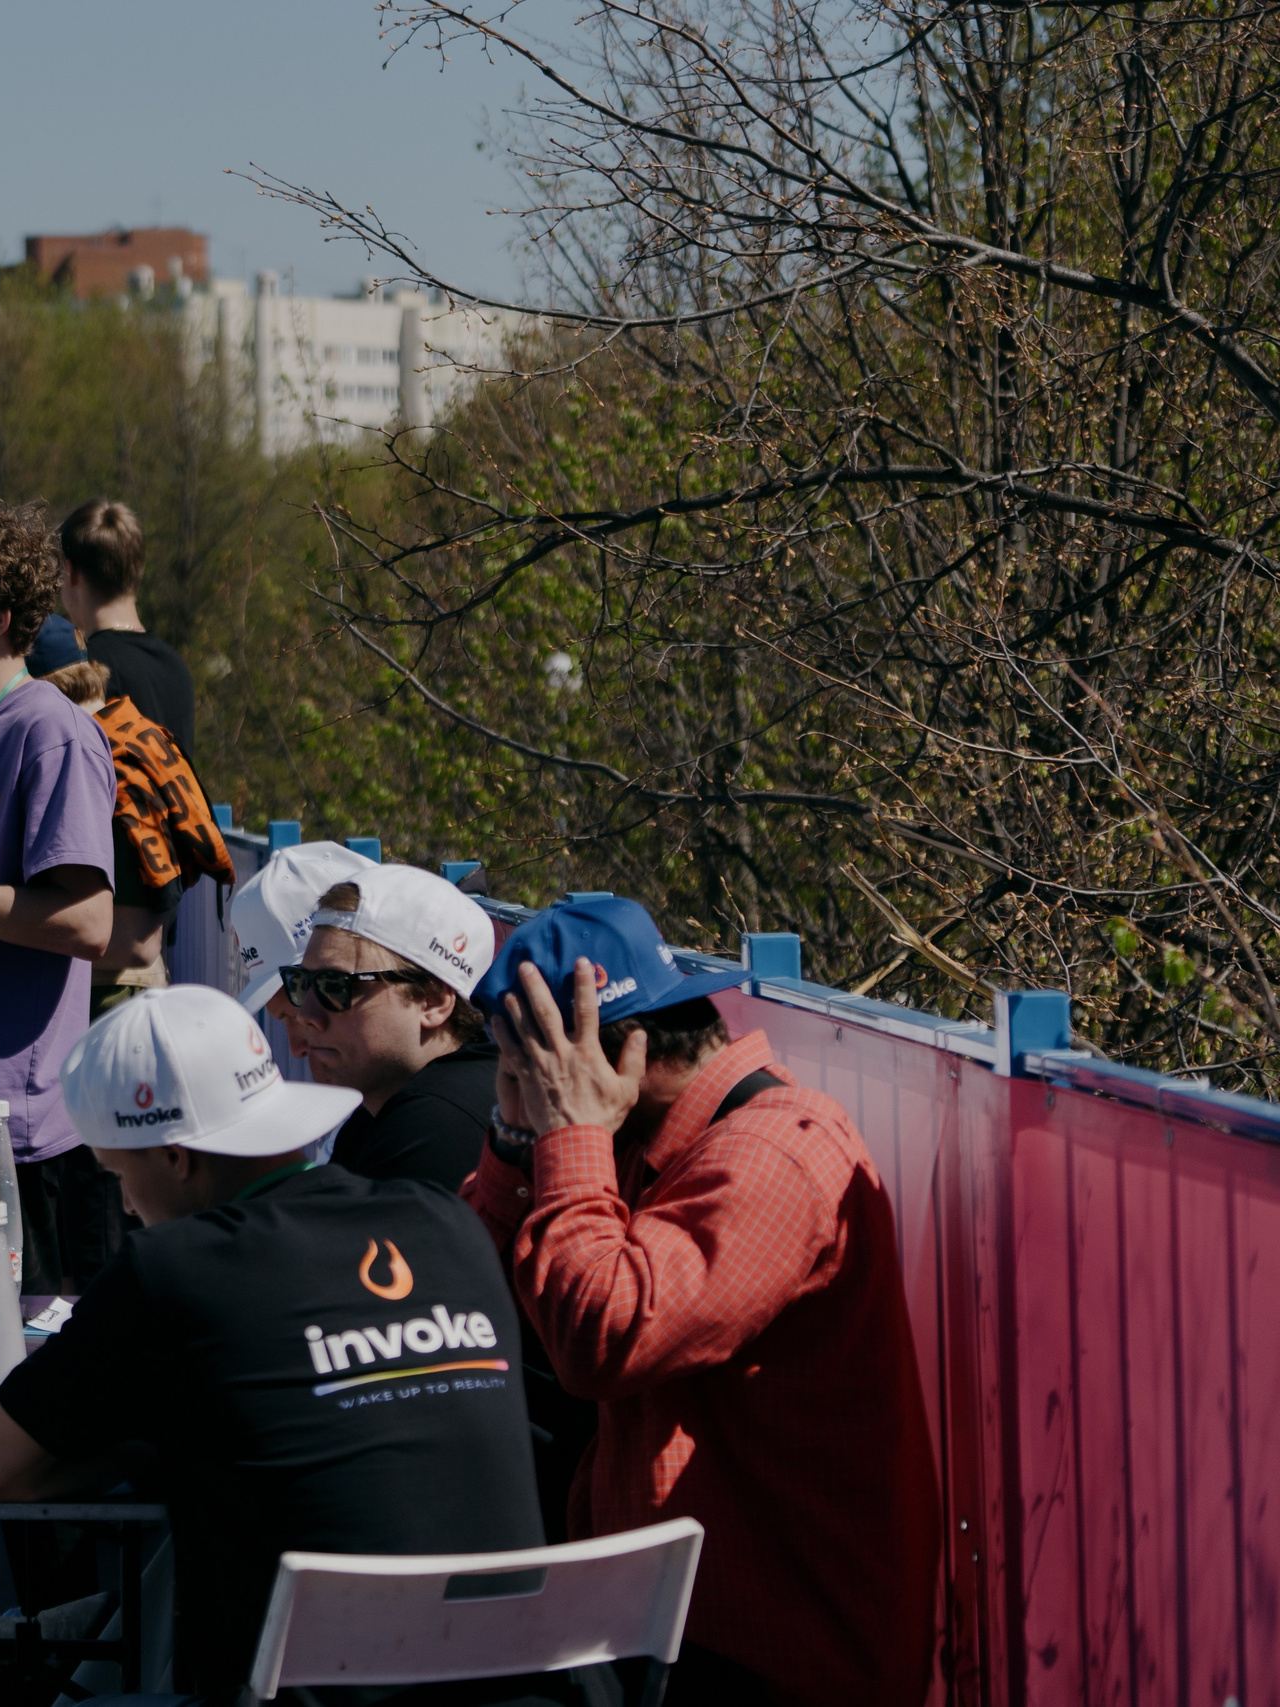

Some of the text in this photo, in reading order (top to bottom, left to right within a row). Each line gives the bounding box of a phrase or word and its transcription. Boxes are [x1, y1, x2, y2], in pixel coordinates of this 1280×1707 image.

[428, 937, 474, 978] invoke
[234, 1058, 275, 1092] invo
[115, 1107, 183, 1128] invoke
[304, 1304, 497, 1374] invoke
[337, 1376, 506, 1409] WAKE UP TO REALITY
